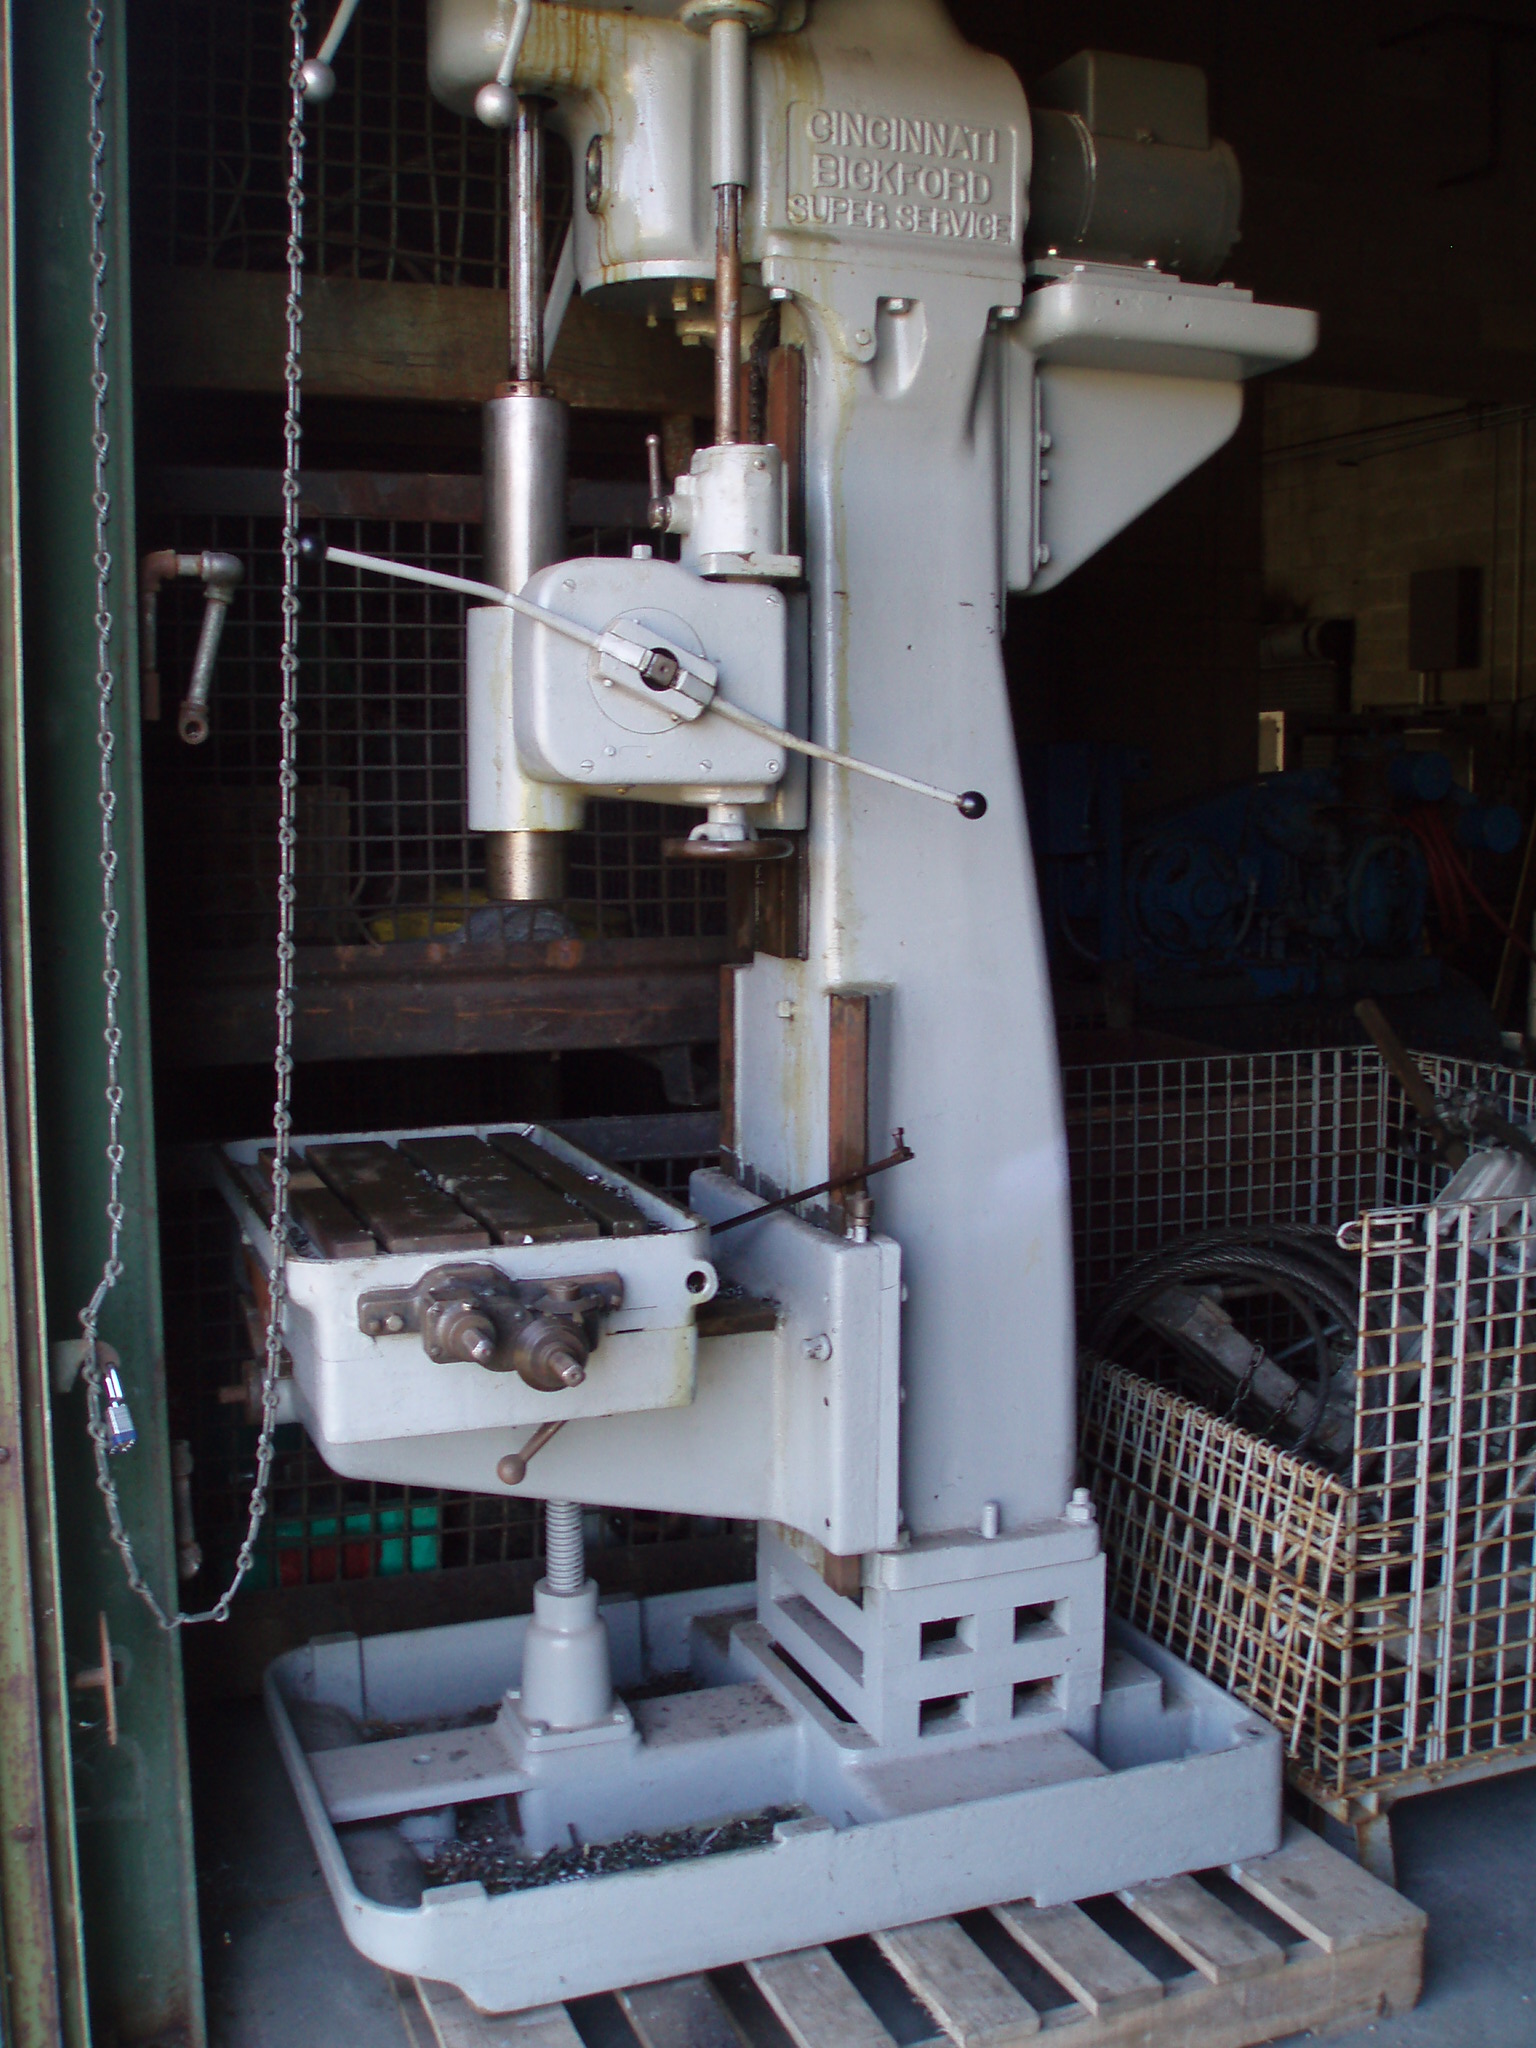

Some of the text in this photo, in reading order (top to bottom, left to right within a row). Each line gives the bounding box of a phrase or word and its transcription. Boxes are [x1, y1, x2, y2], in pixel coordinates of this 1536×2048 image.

[807, 109, 998, 163] CINCINNATI
[812, 153, 992, 205] BICKFORD
[788, 193, 1012, 245] SUPER SERVICE
